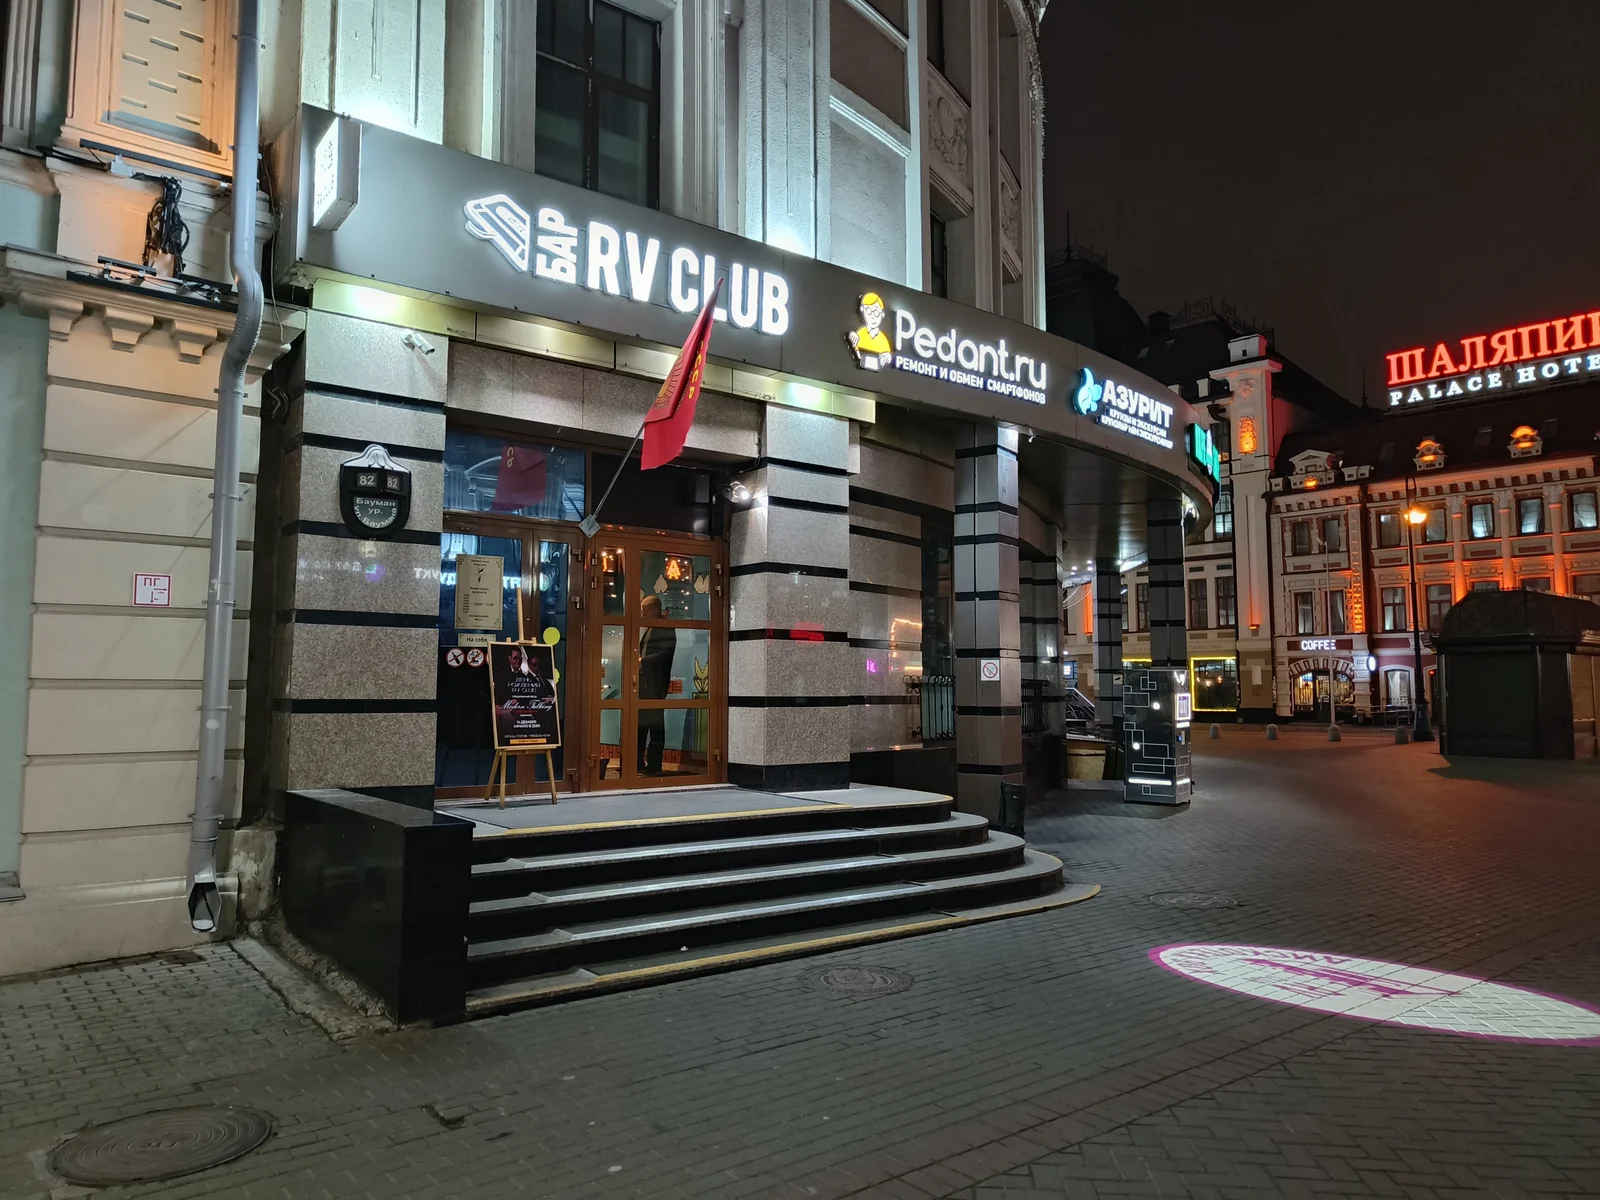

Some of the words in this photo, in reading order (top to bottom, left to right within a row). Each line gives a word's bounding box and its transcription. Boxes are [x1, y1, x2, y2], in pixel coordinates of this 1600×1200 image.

[535, 207, 579, 285] БАР
[585, 220, 660, 302] RV
[668, 247, 789, 336] CLUB
[895, 309, 1047, 390] Pedant.ru
[896, 356, 938, 377] РЕМОНТ
[939, 367, 949, 380] И
[949, 371, 984, 389] ОБМЕН
[986, 379, 1046, 405] СМАРТФОНОВ
[1390, 373, 1503, 406] PALACE
[1103, 380, 1174, 428] АЗУРИТ
[360, 475, 375, 485] 82
[387, 477, 398, 488] 82
[356, 497, 396, 507] Бауман
[362, 508, 398, 528] Баумана
[144, 577, 161, 586] ПГ
[1301, 639, 1337, 651] COFFEE
[498, 699, 525, 710] Modern
[526, 699, 553, 712] Talking
